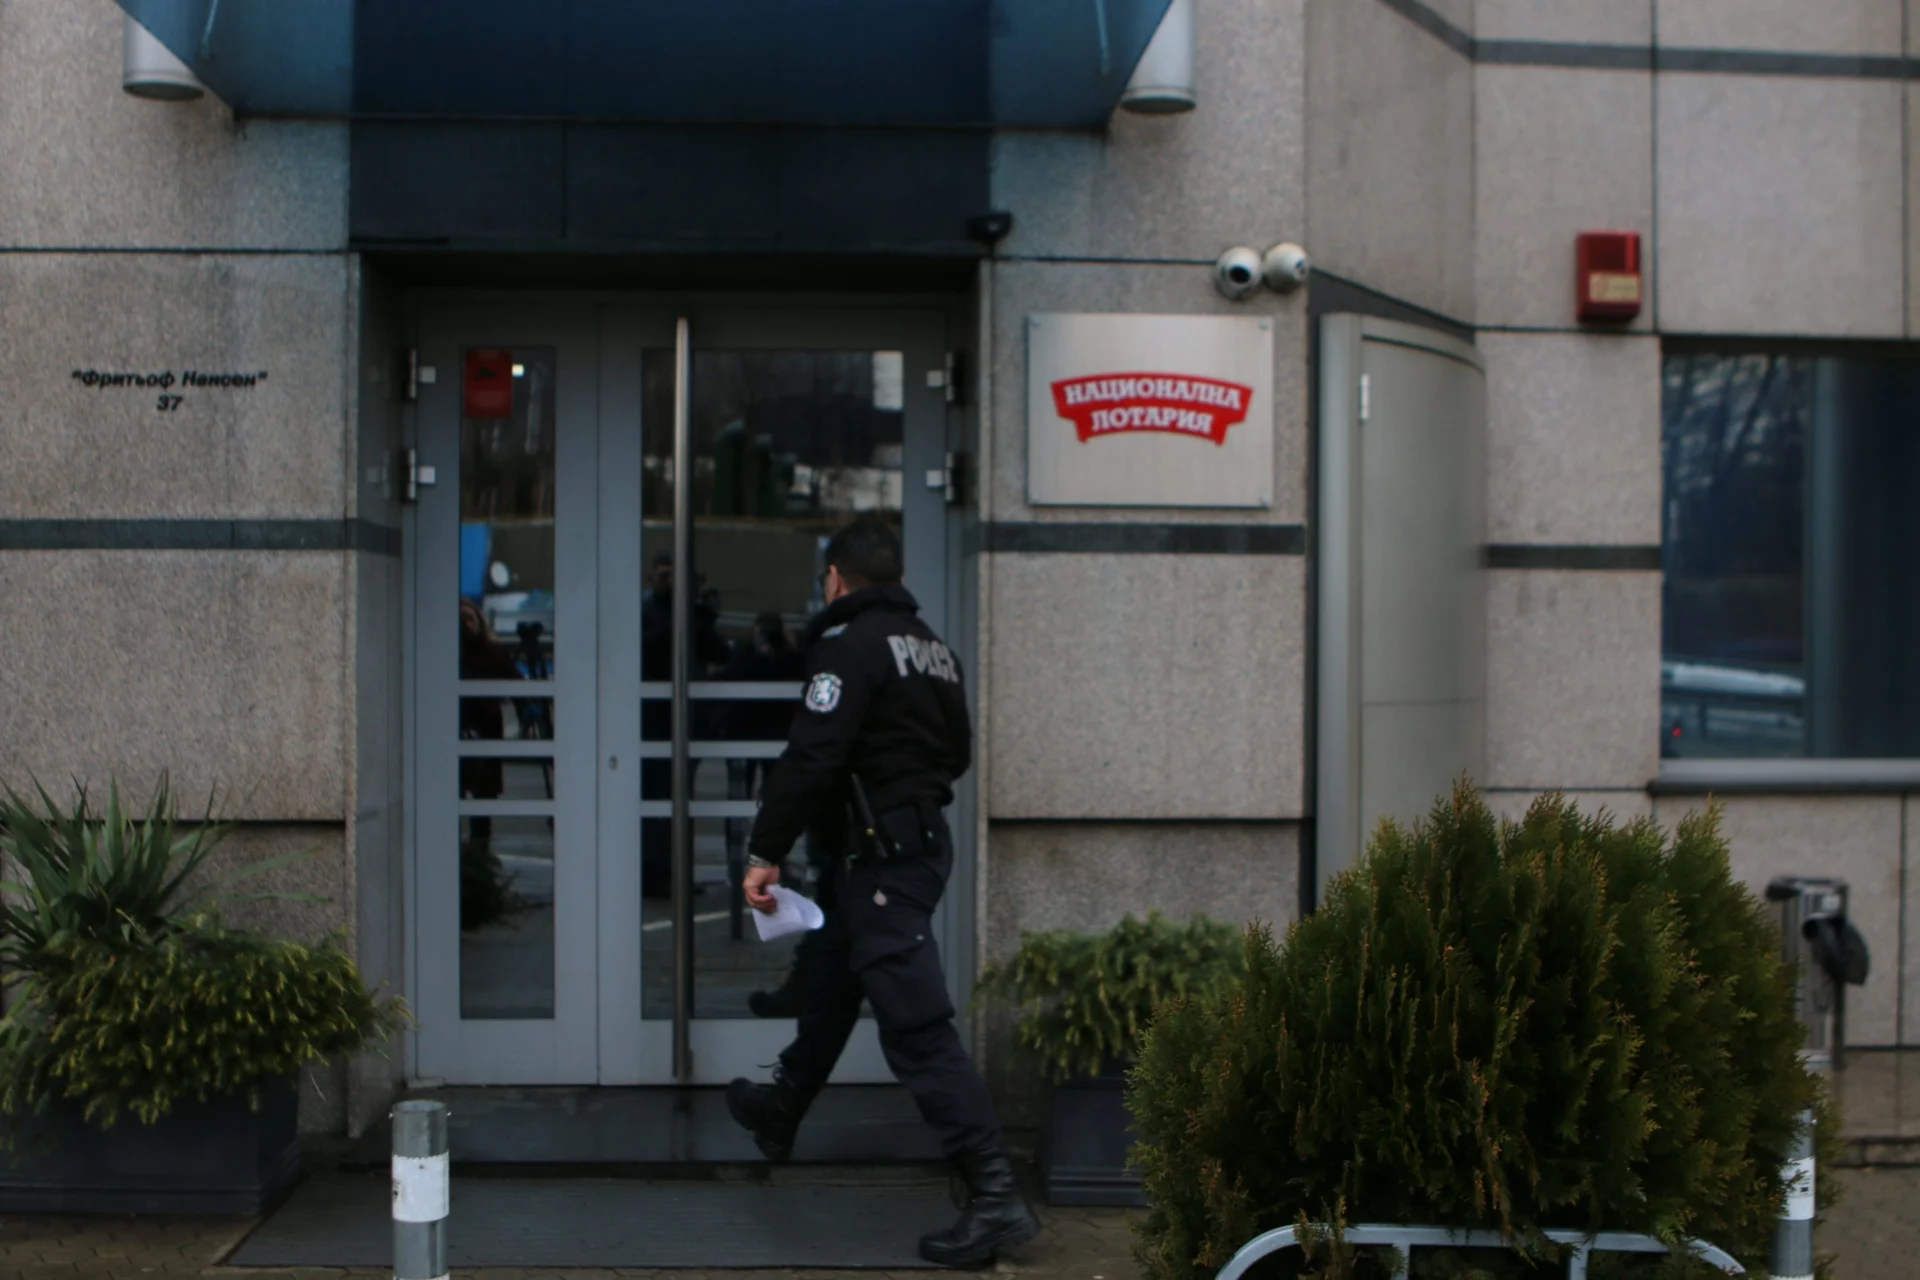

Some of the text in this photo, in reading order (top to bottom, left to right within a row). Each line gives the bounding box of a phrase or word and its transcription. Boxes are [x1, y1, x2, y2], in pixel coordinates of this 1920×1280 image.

[157, 394, 183, 411] 37
[1064, 378, 1241, 409] НАЦИОНАЛНА
[1090, 406, 1213, 433] ЛОТАРИЯ
